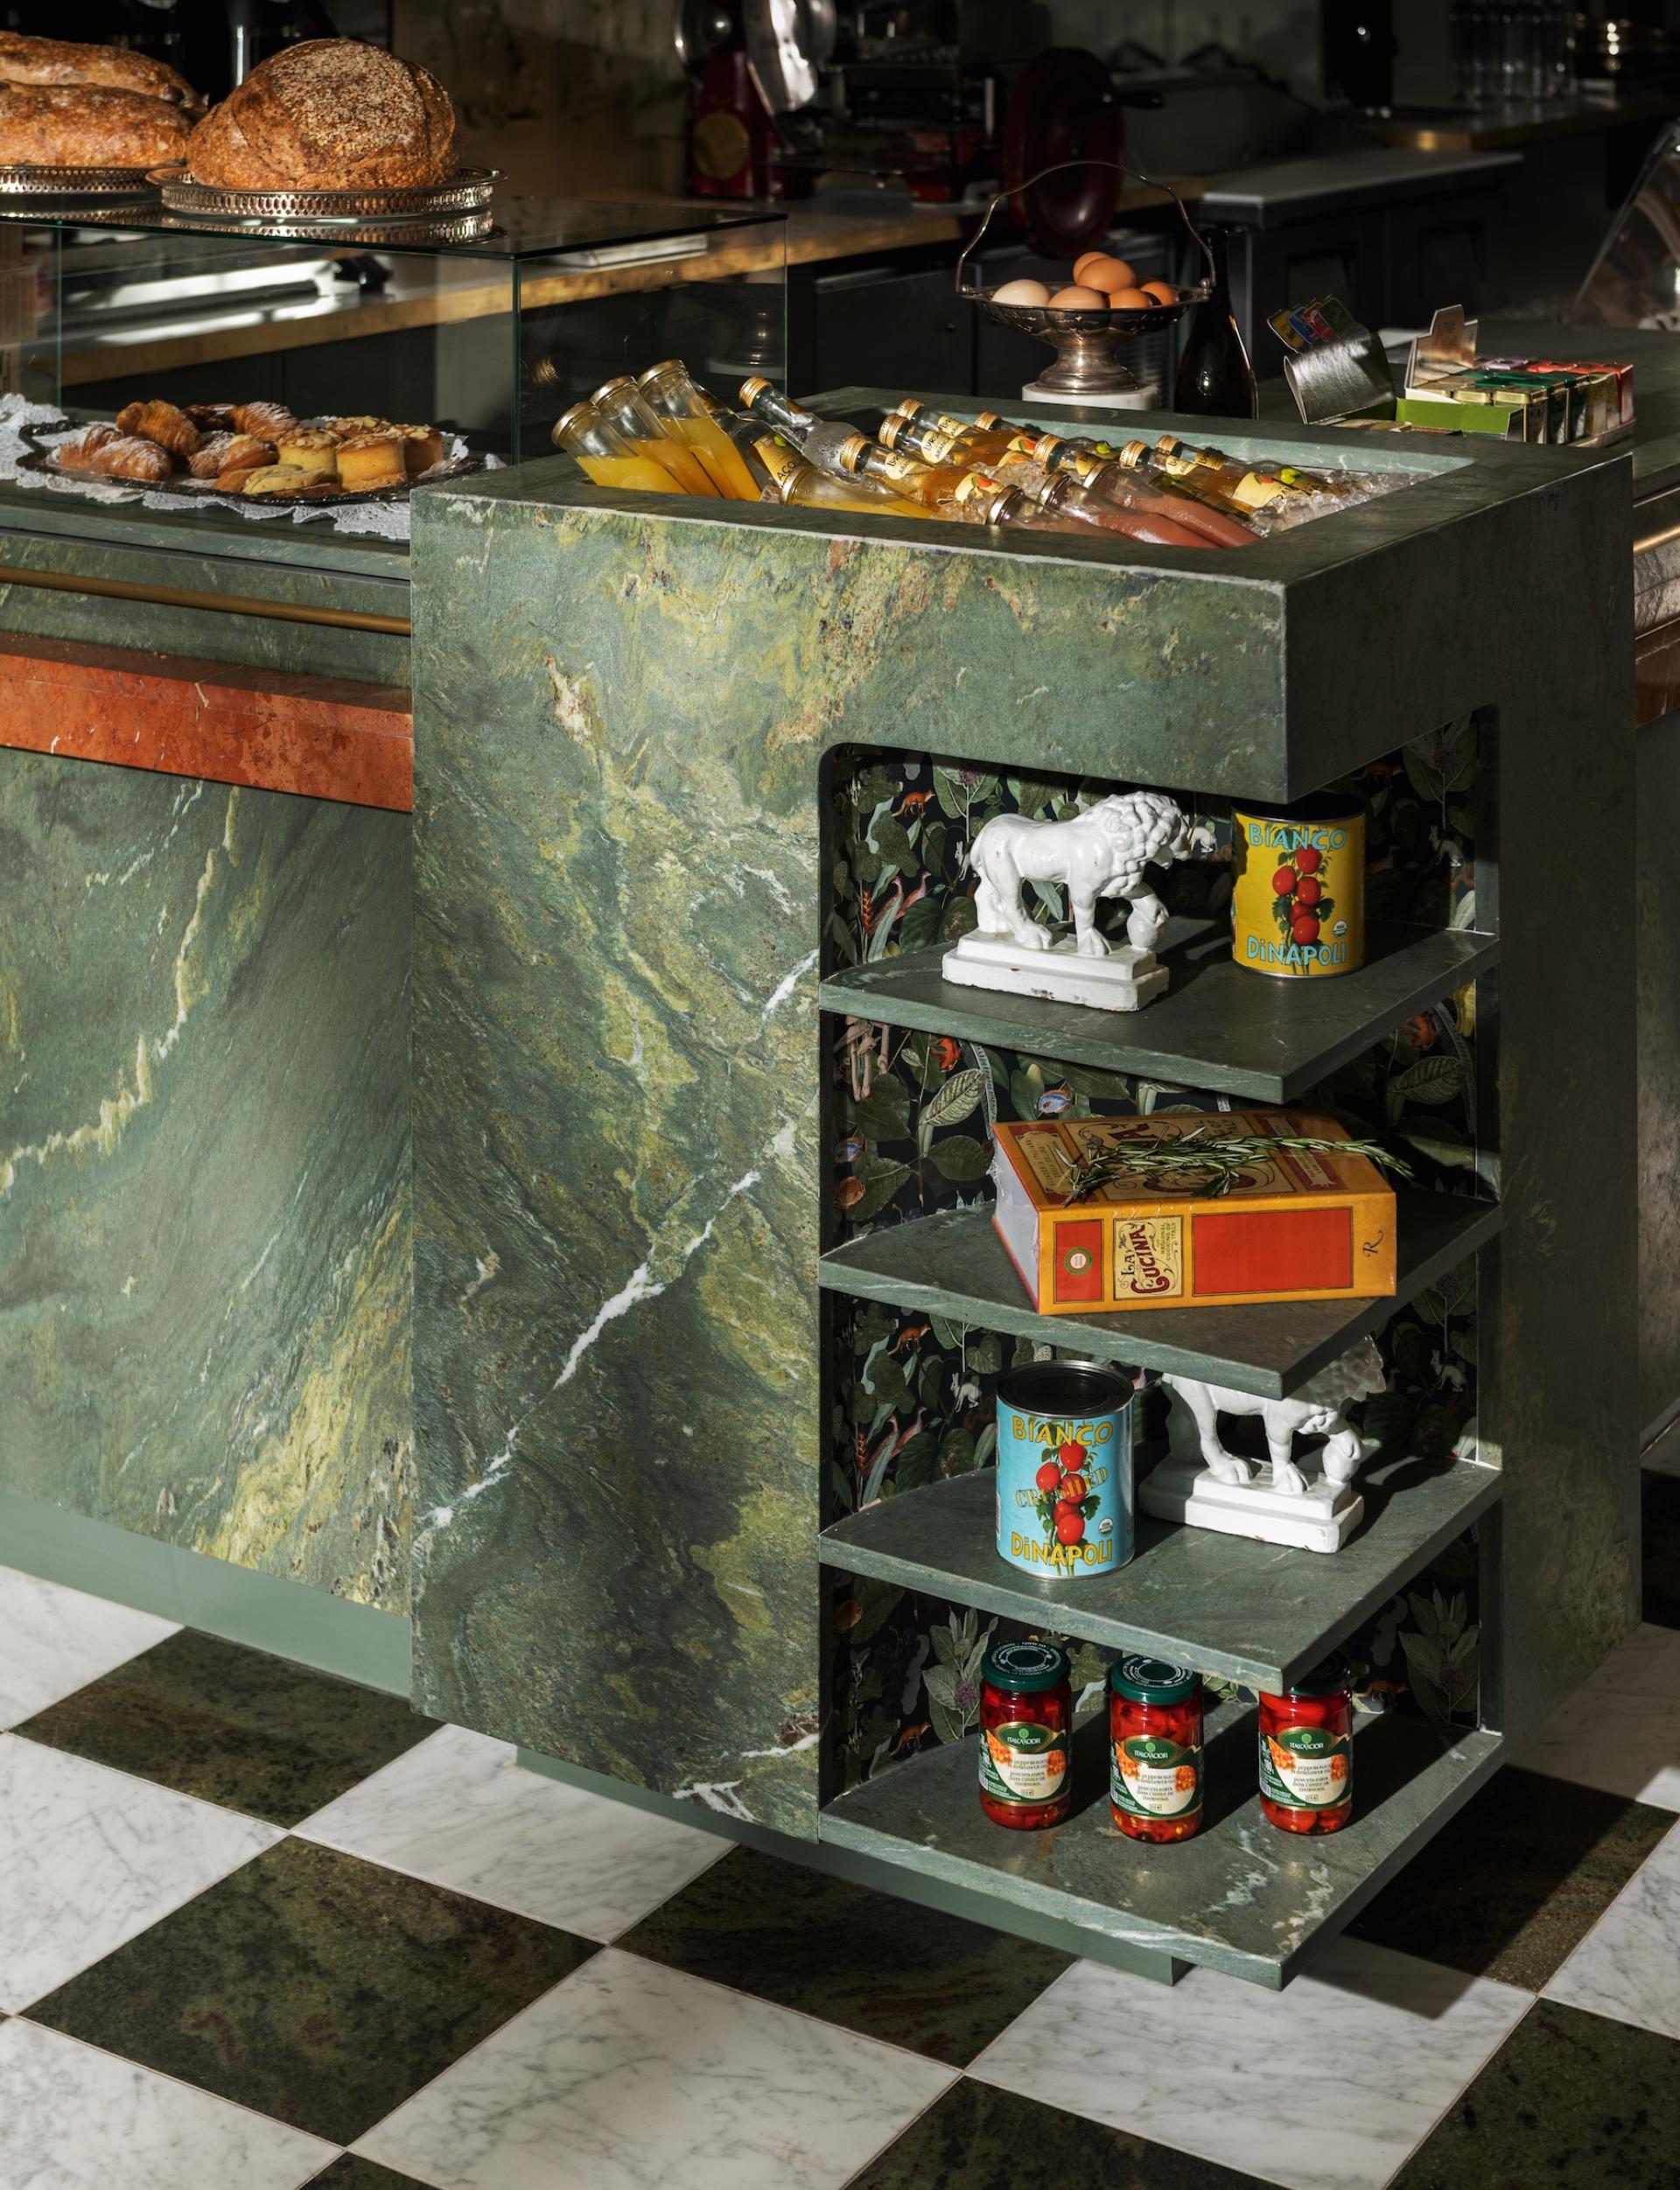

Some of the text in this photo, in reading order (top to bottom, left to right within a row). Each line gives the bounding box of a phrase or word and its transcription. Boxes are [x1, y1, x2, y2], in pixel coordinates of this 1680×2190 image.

[1249, 823, 1348, 851] BIANCO
[1121, 1253, 1135, 1276] LA
[1129, 1224, 1171, 1294] CUCINA
[1012, 1415, 1114, 1447] BIANCO
[1015, 1466, 1110, 1508] CRUSHED
